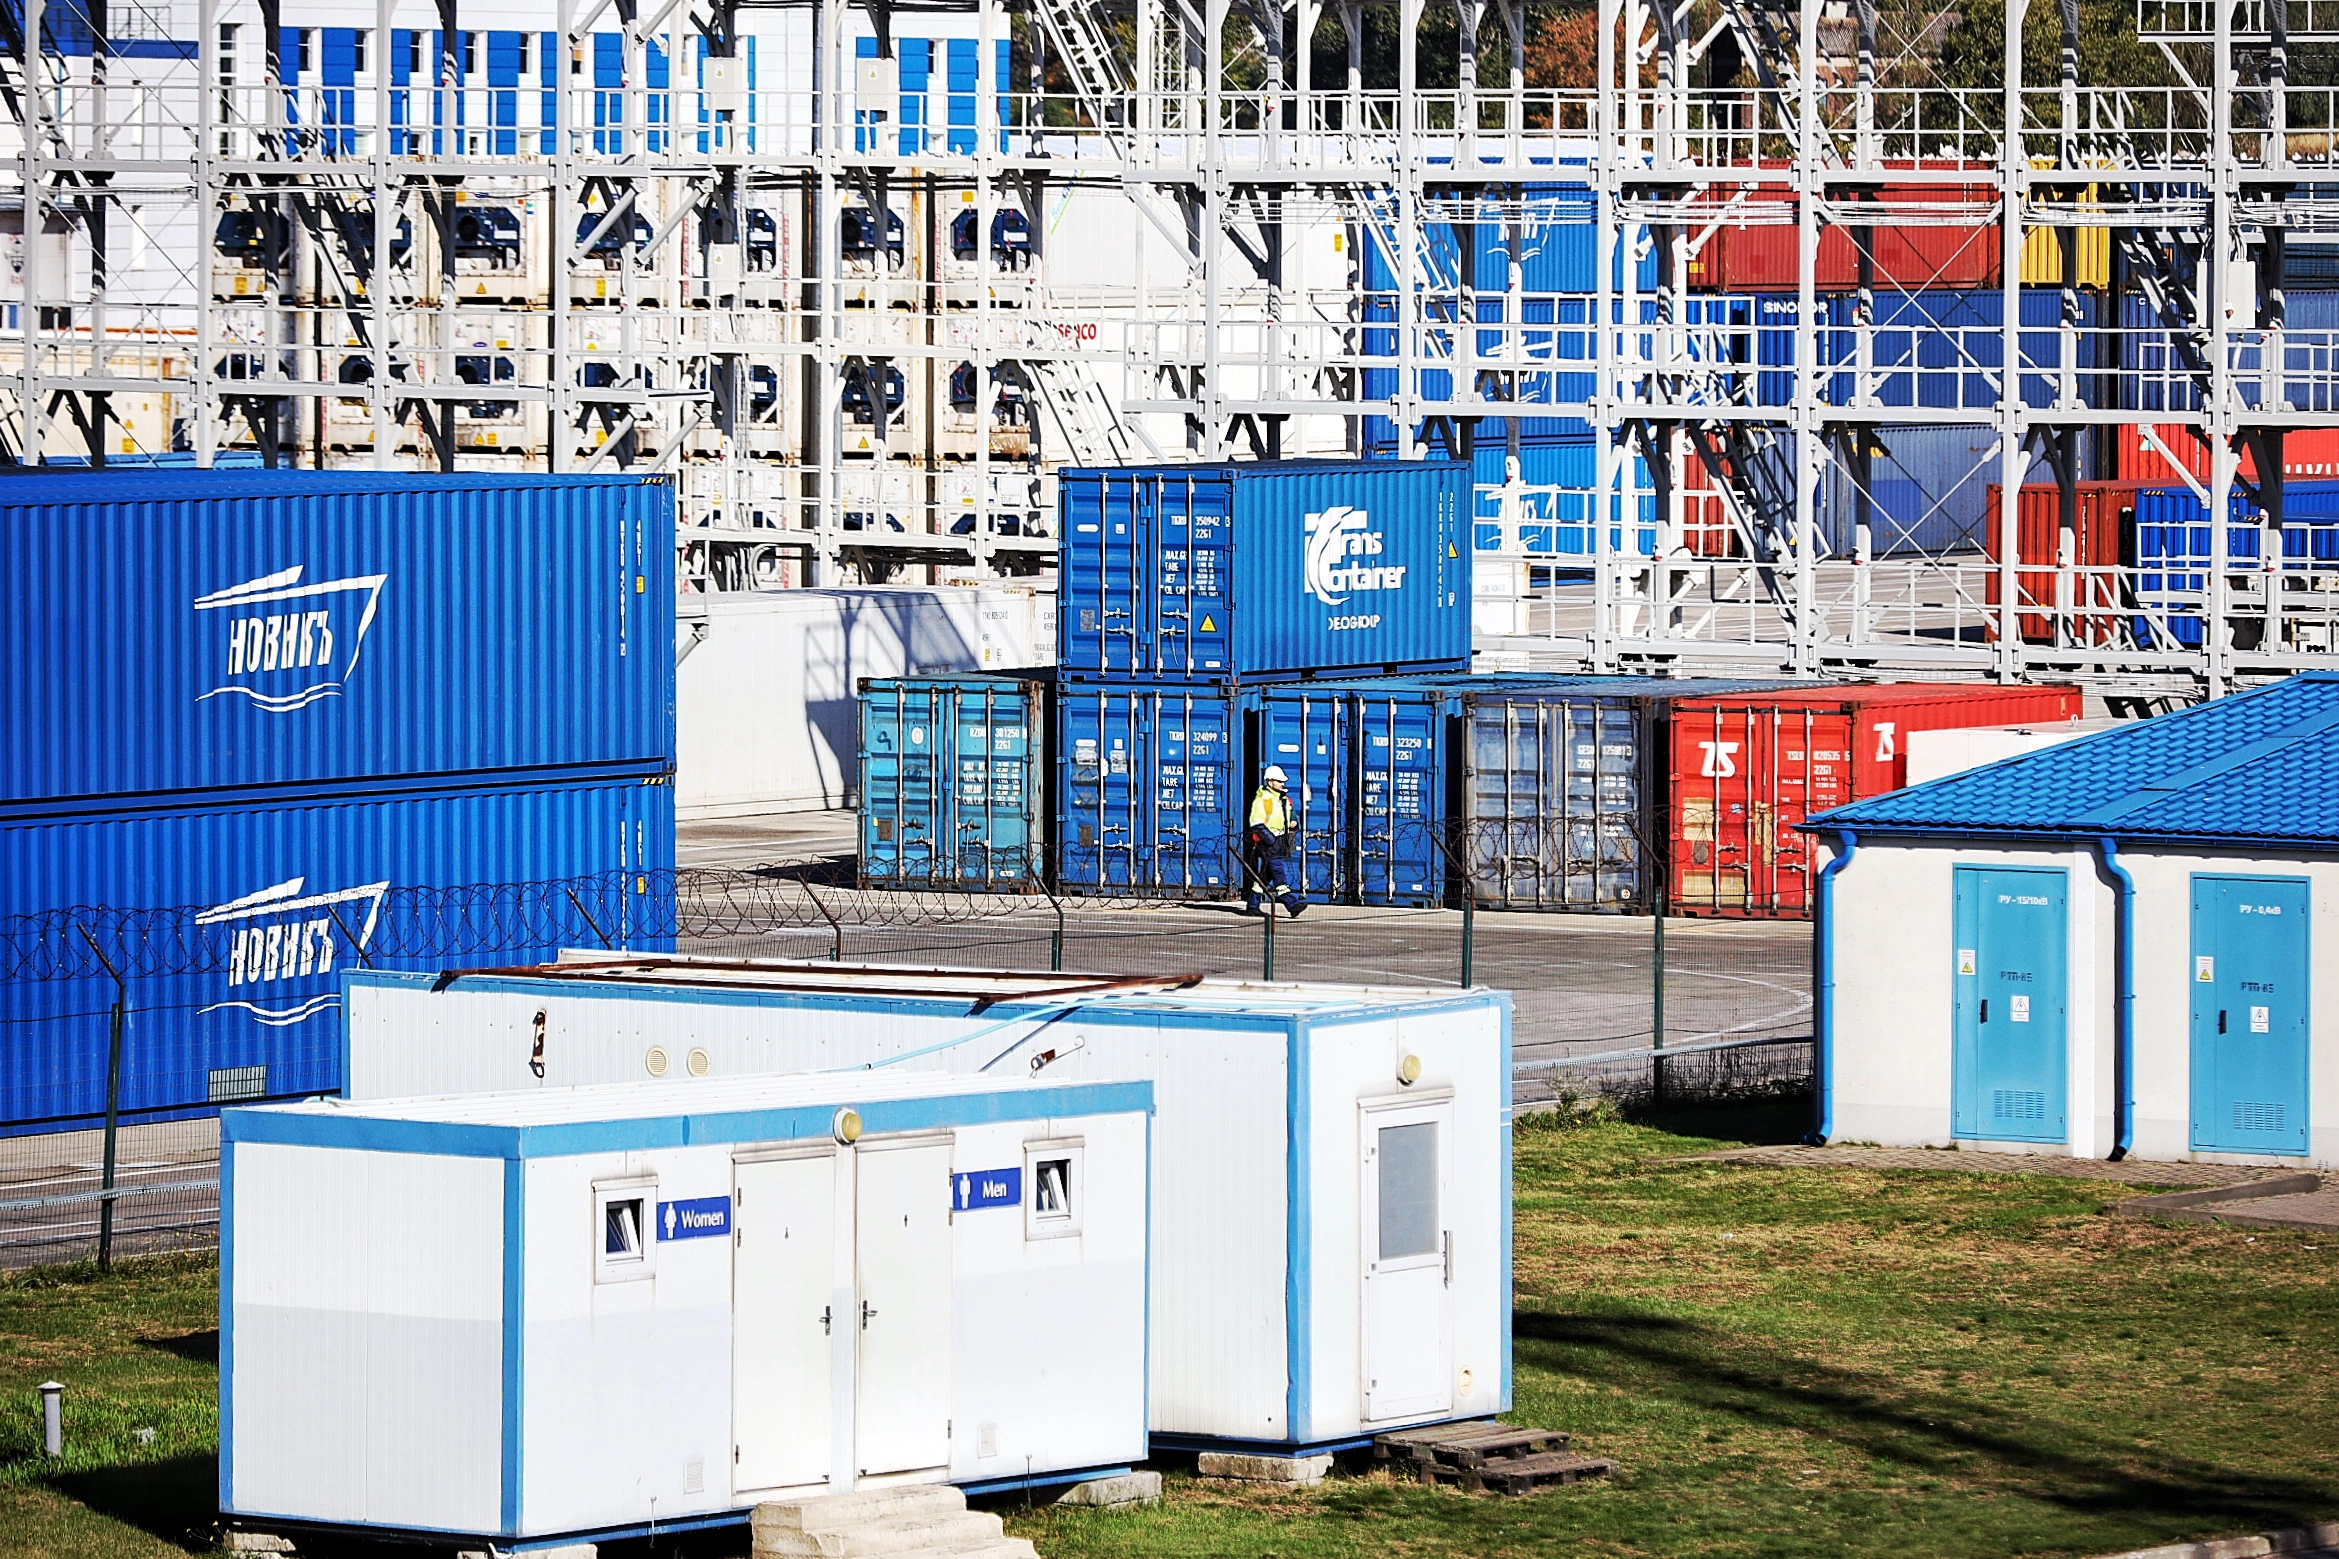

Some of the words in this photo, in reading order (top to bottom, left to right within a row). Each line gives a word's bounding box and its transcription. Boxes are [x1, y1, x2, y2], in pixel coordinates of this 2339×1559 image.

[1763, 301, 1828, 314] SINOOR
[1195, 516, 1221, 527] 350942
[995, 728, 1019, 738] 301250
[1193, 731, 1218, 742] 324099
[1396, 737, 1422, 748] 323250
[982, 1178, 1007, 1199] Men
[681, 1210, 724, 1229] Women
